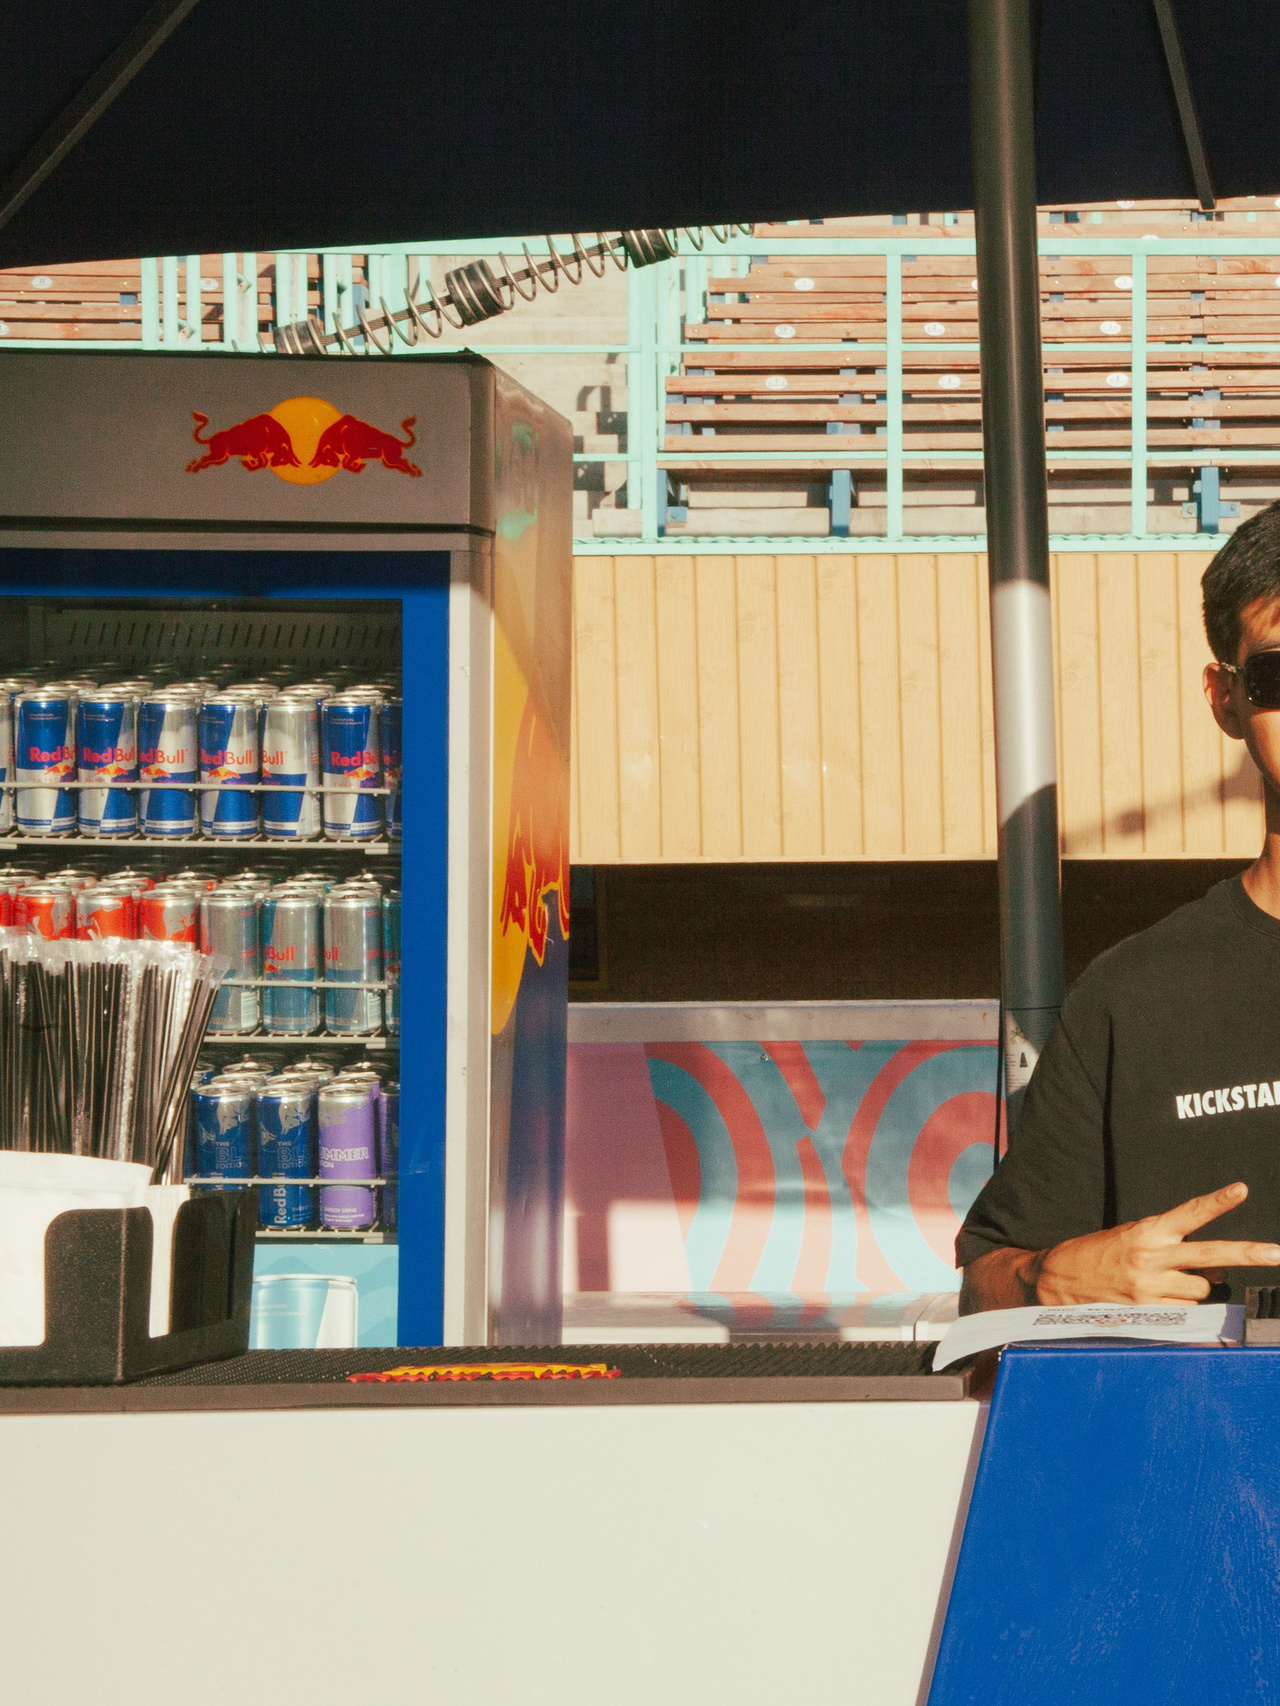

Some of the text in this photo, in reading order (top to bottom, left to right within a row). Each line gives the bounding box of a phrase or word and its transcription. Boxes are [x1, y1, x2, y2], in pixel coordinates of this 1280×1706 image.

[30, 746, 61, 762] Red
[155, 749, 184, 764] Bull
[224, 749, 252, 765] Bull
[330, 751, 361, 766] Red
[273, 1198, 287, 1224] Red
